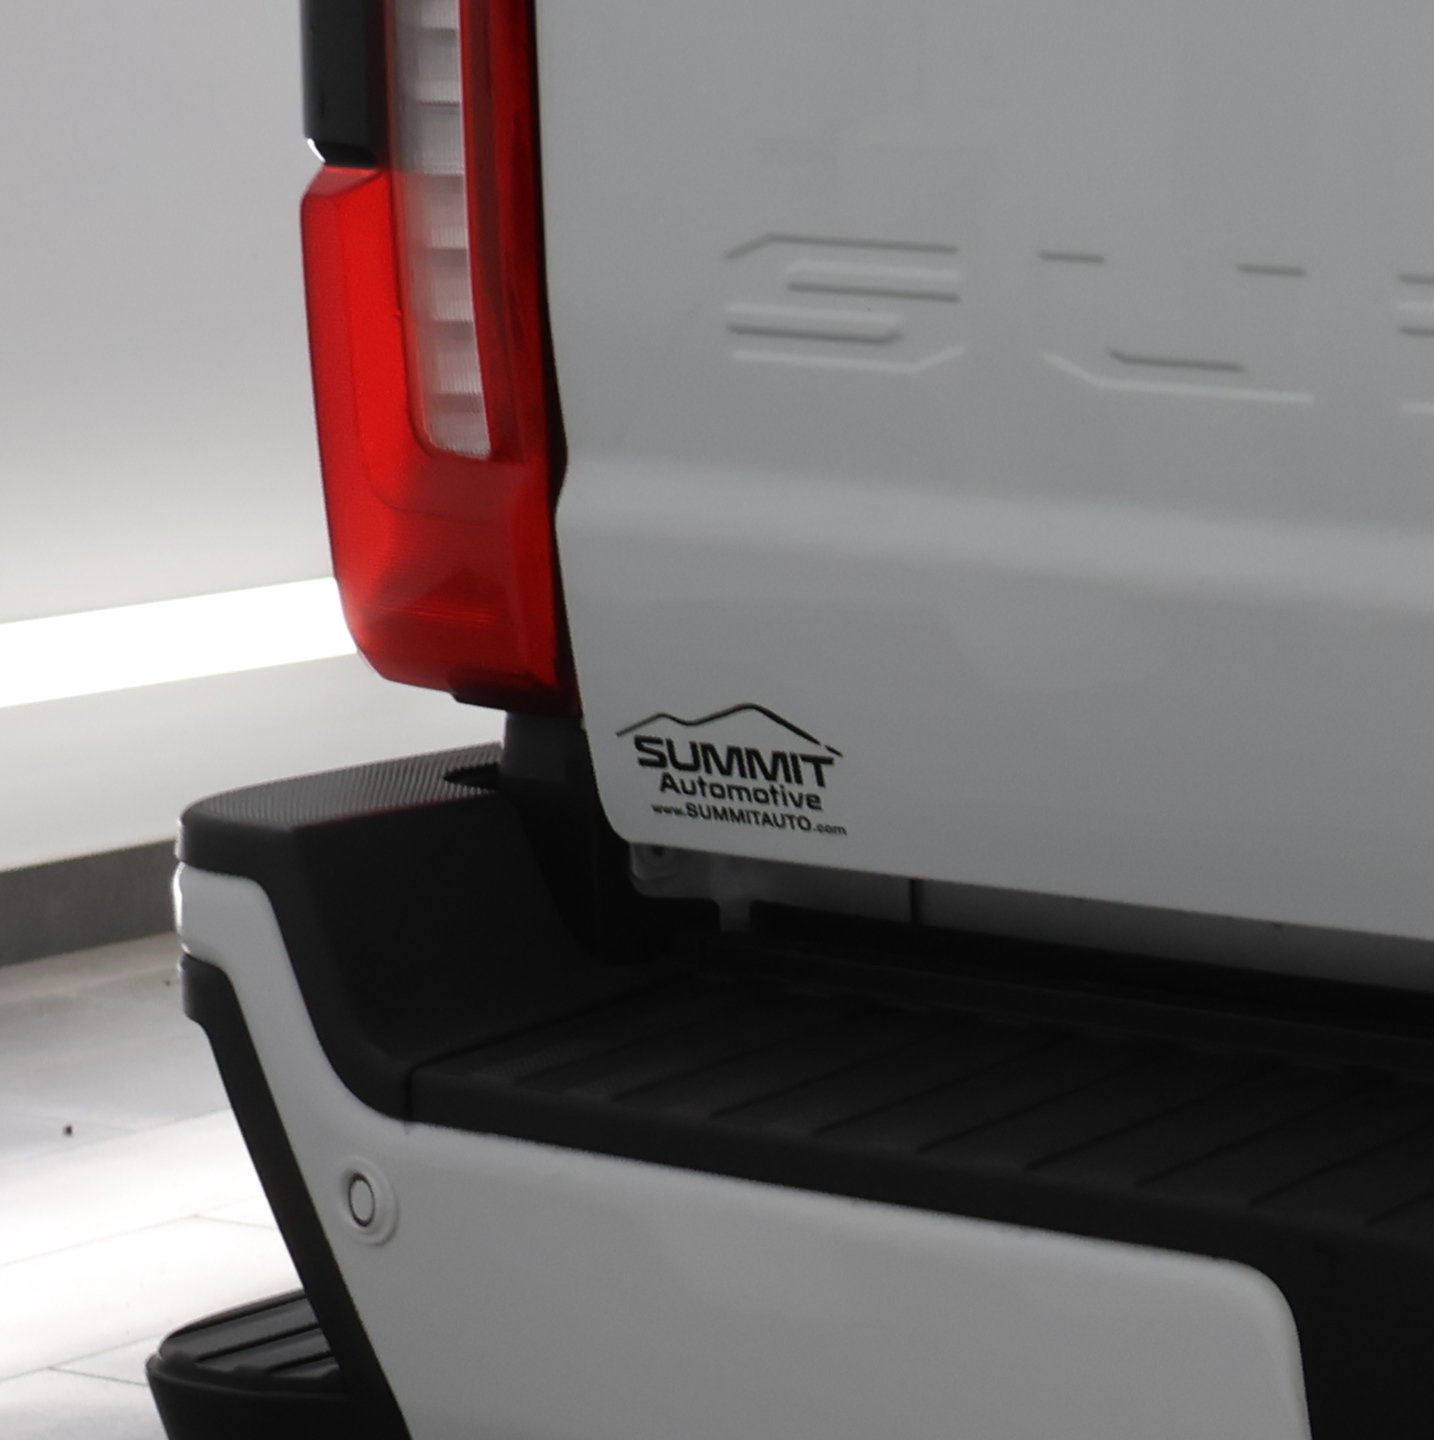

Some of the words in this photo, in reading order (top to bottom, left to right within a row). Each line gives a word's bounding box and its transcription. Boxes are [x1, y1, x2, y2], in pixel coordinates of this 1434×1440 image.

[634, 734, 835, 788] SUMMIT
[659, 771, 823, 811] Automotive
[651, 802, 848, 836] www.SUMMITAUTO.com
